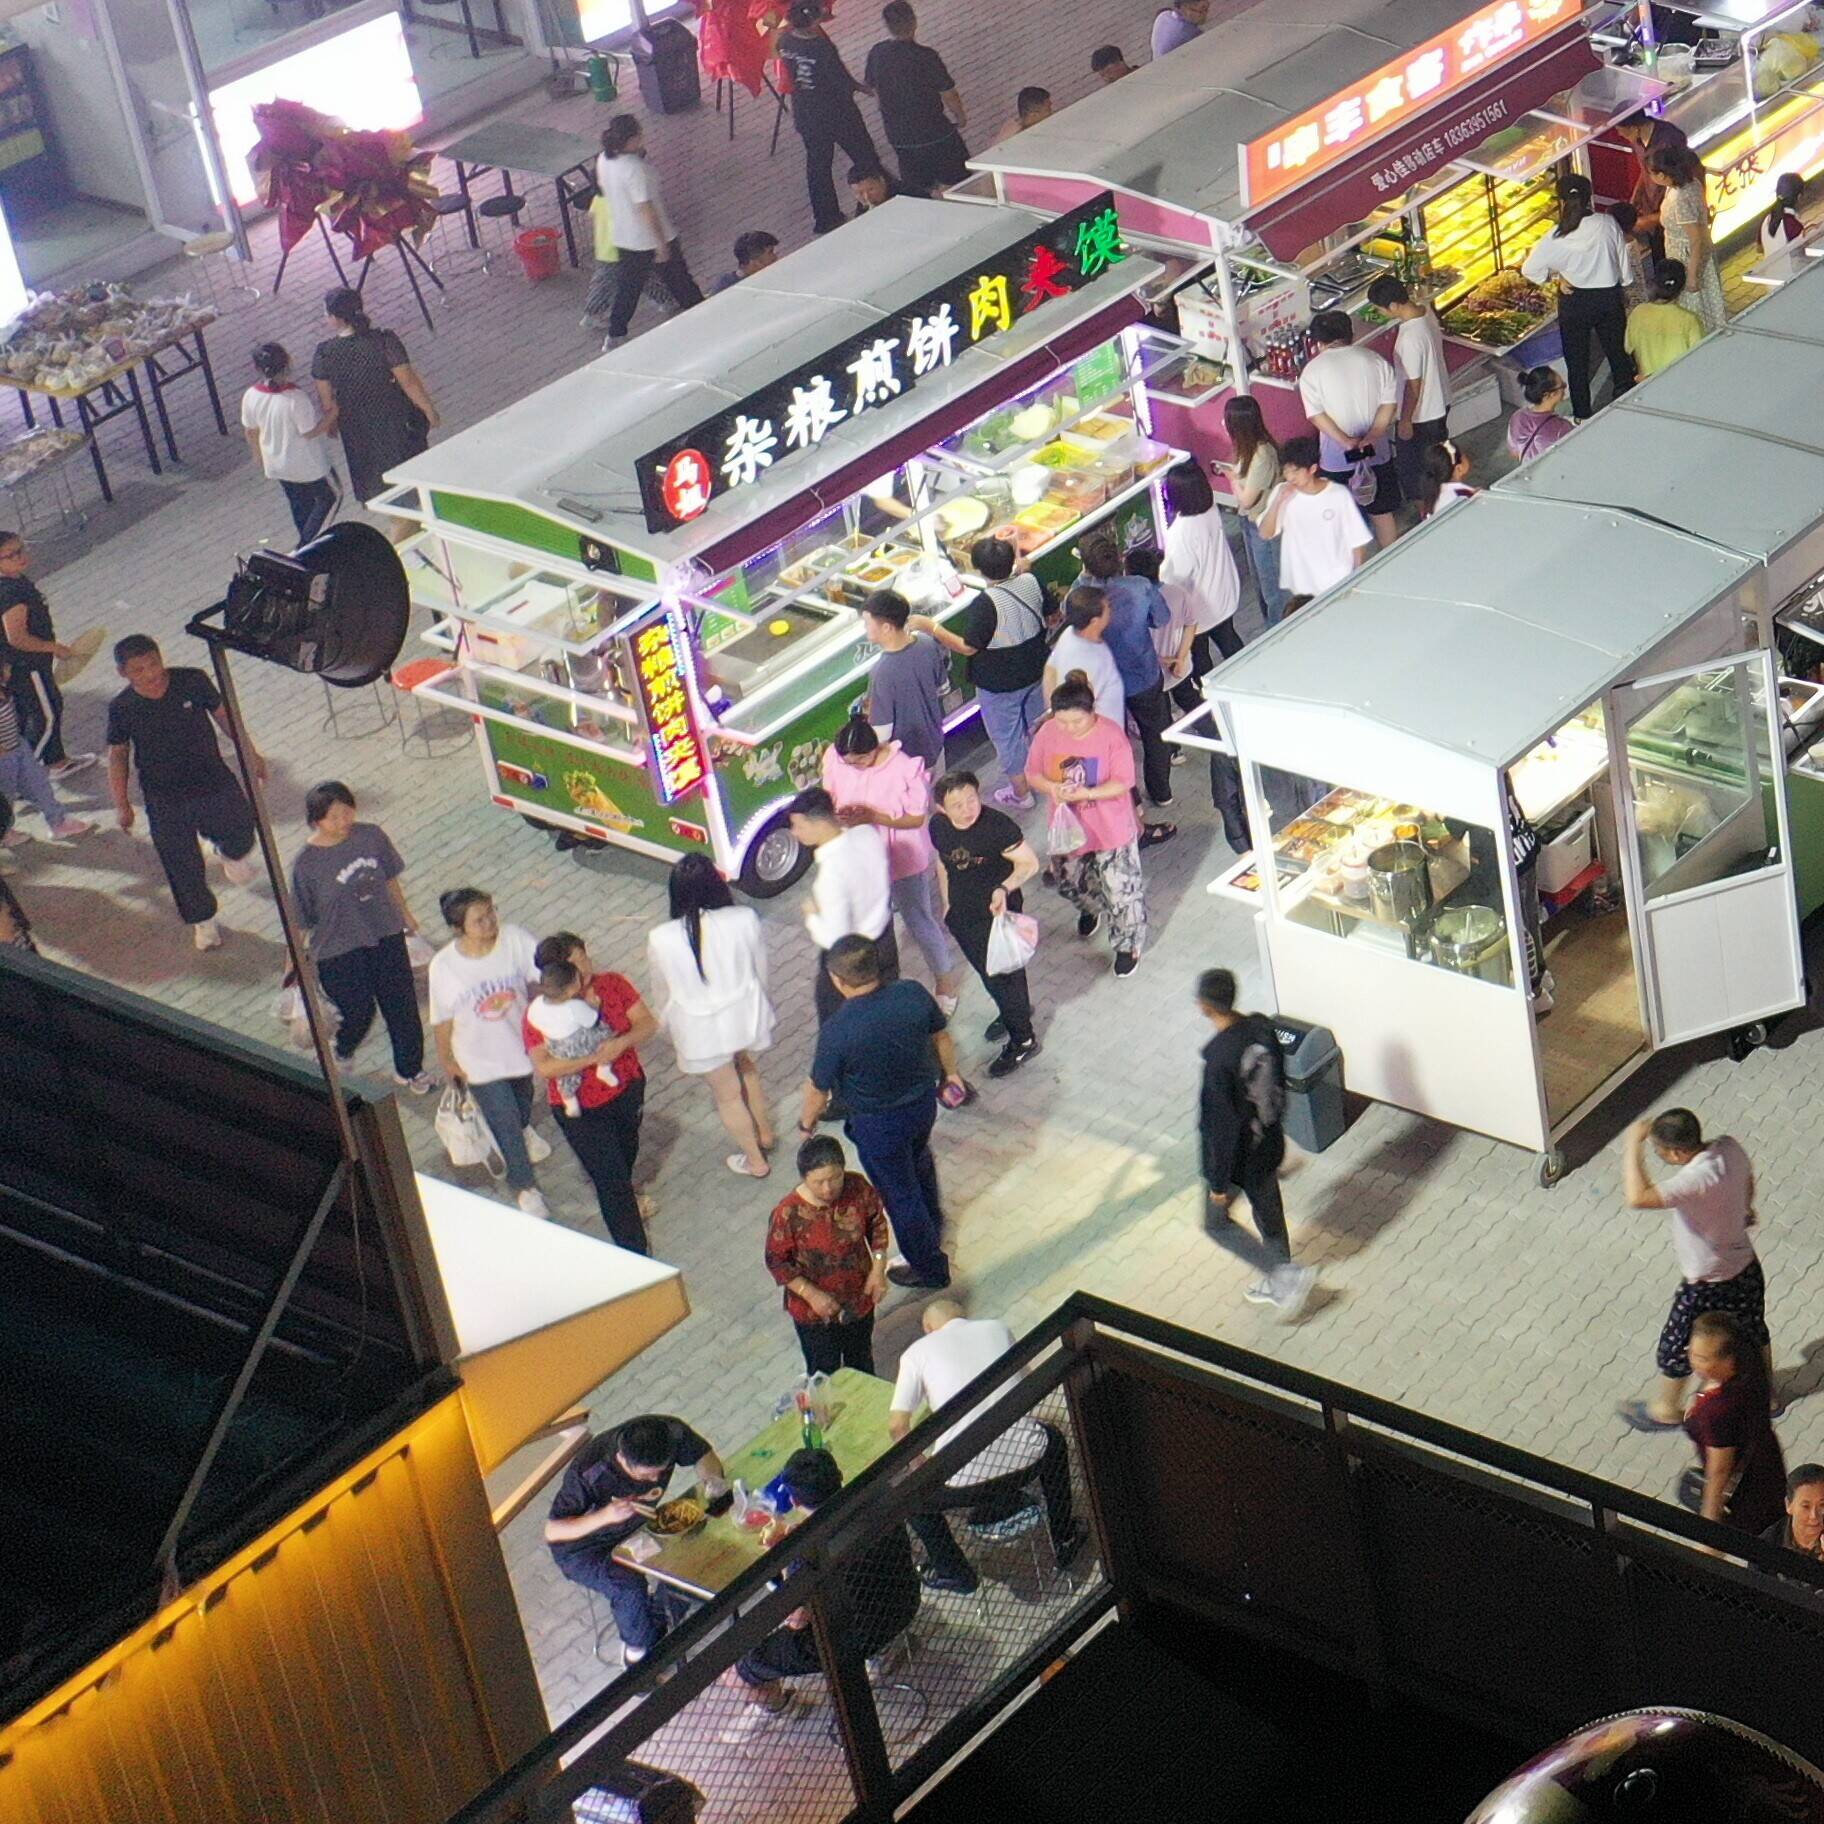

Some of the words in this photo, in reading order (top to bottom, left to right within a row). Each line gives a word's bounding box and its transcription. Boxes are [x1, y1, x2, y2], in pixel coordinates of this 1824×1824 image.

[720, 207, 1128, 488] 杂粮煎饼肉夹馍
[637, 623, 704, 795] 杂粮煎饼肉夹馍
